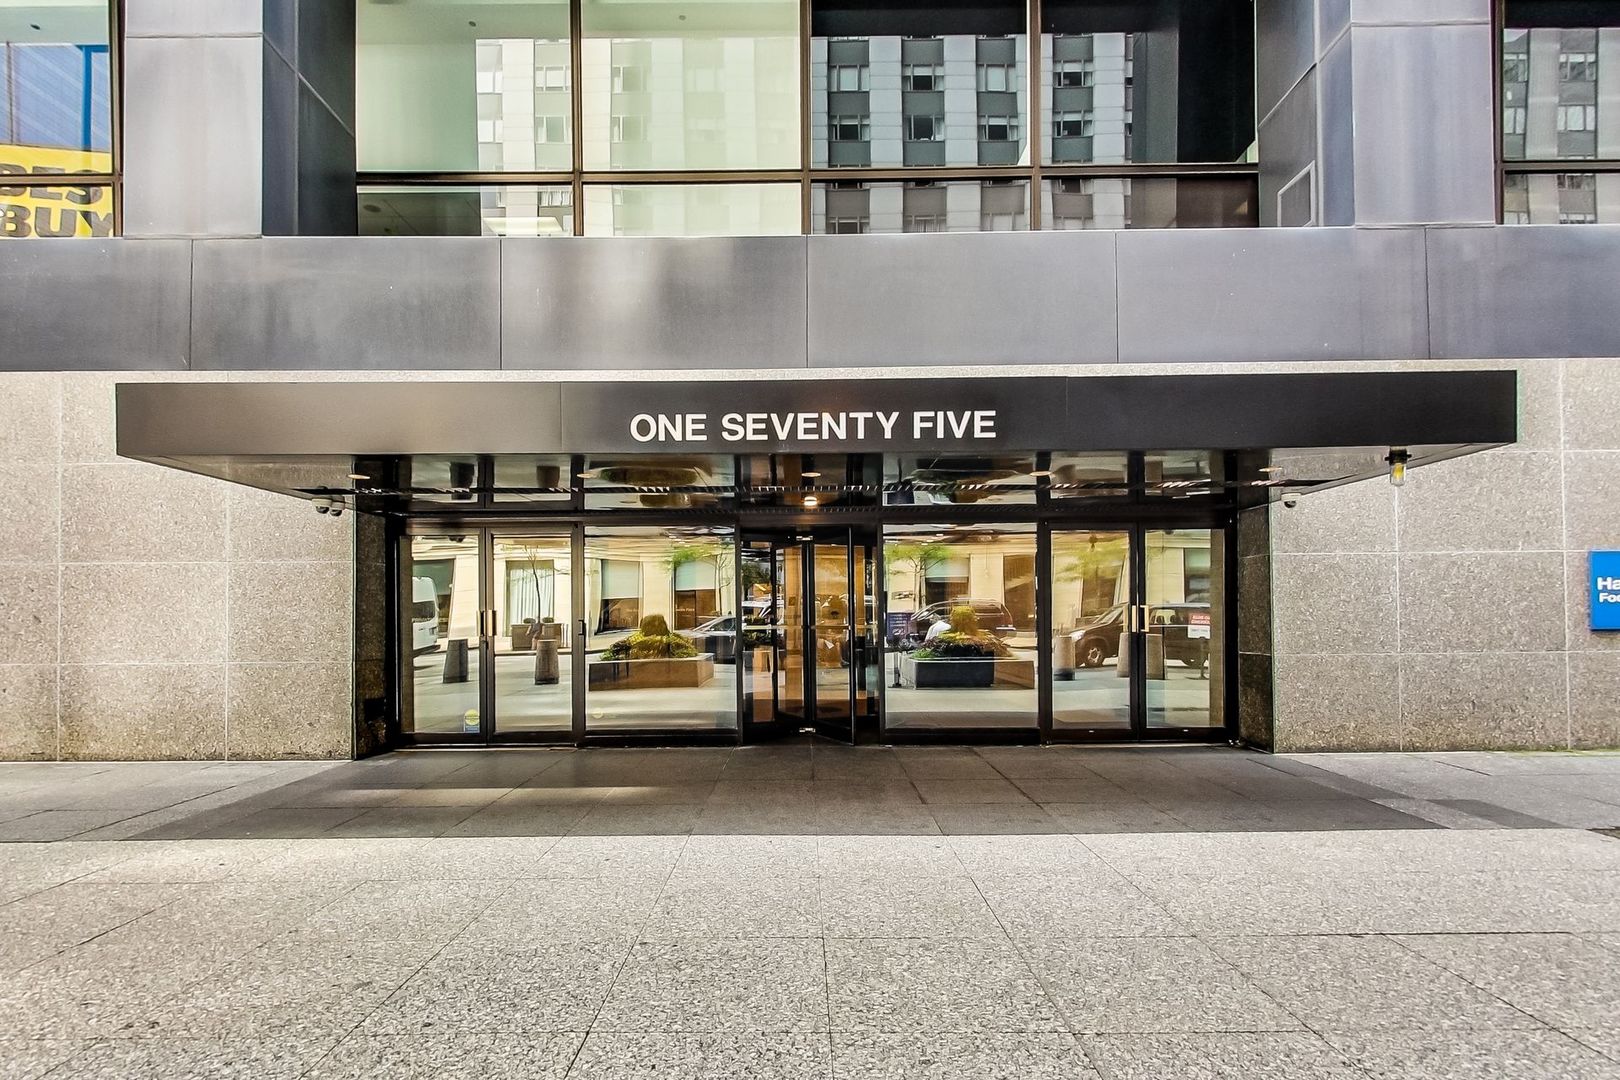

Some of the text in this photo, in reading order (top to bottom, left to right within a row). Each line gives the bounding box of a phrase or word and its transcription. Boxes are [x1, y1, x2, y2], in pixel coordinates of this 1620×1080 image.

[0, 204, 113, 238] BUY
[629, 410, 997, 442] ONE SEVENTY FIVE
